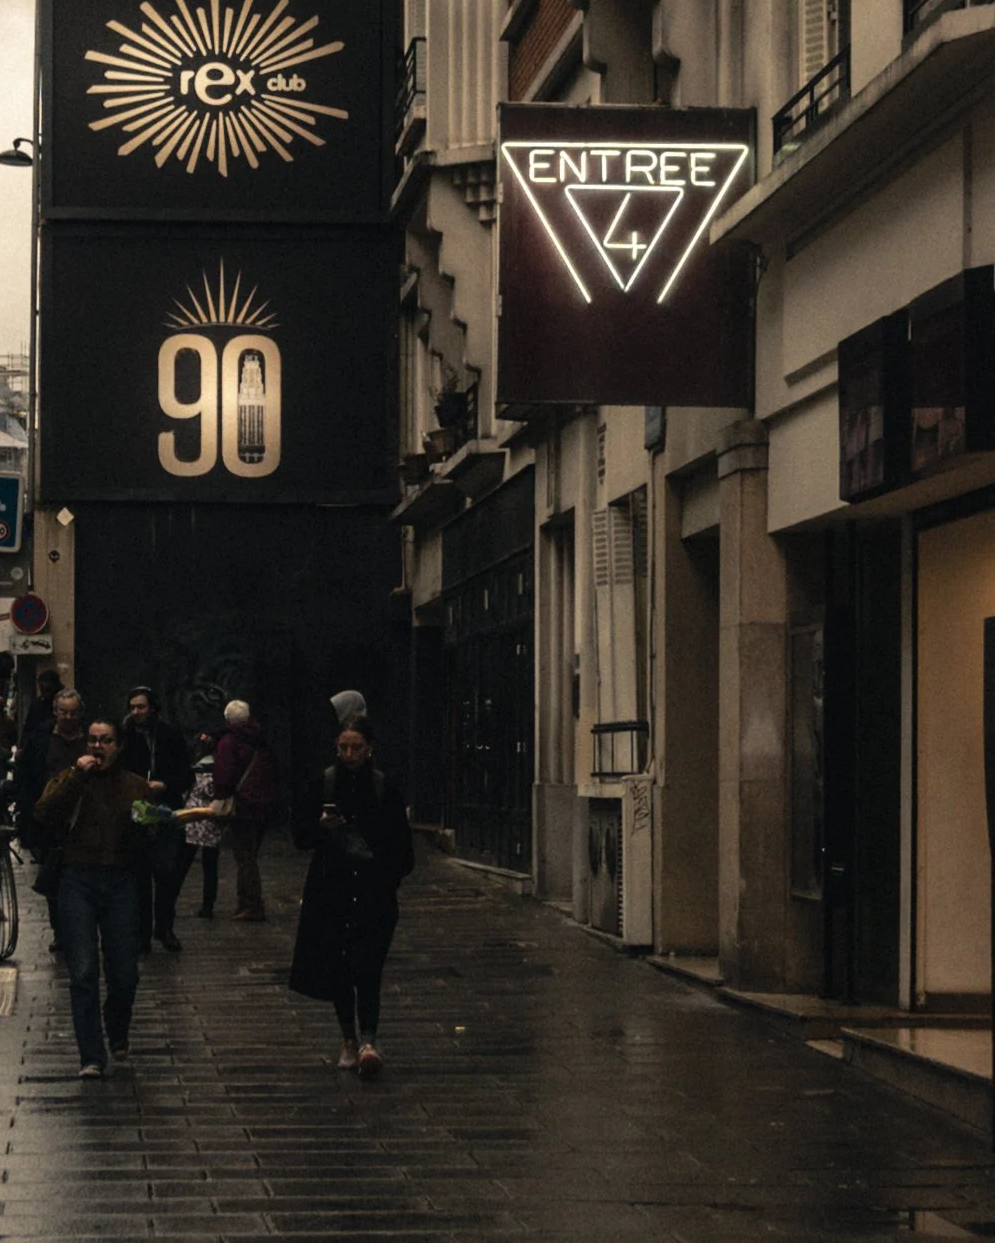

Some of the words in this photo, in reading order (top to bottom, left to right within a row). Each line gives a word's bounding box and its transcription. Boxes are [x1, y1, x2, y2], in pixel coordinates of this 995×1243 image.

[180, 61, 256, 106] rex
[266, 73, 306, 92] club
[529, 149, 716, 187] ENTREE
[603, 192, 647, 260] 4
[158, 333, 282, 478] 90
